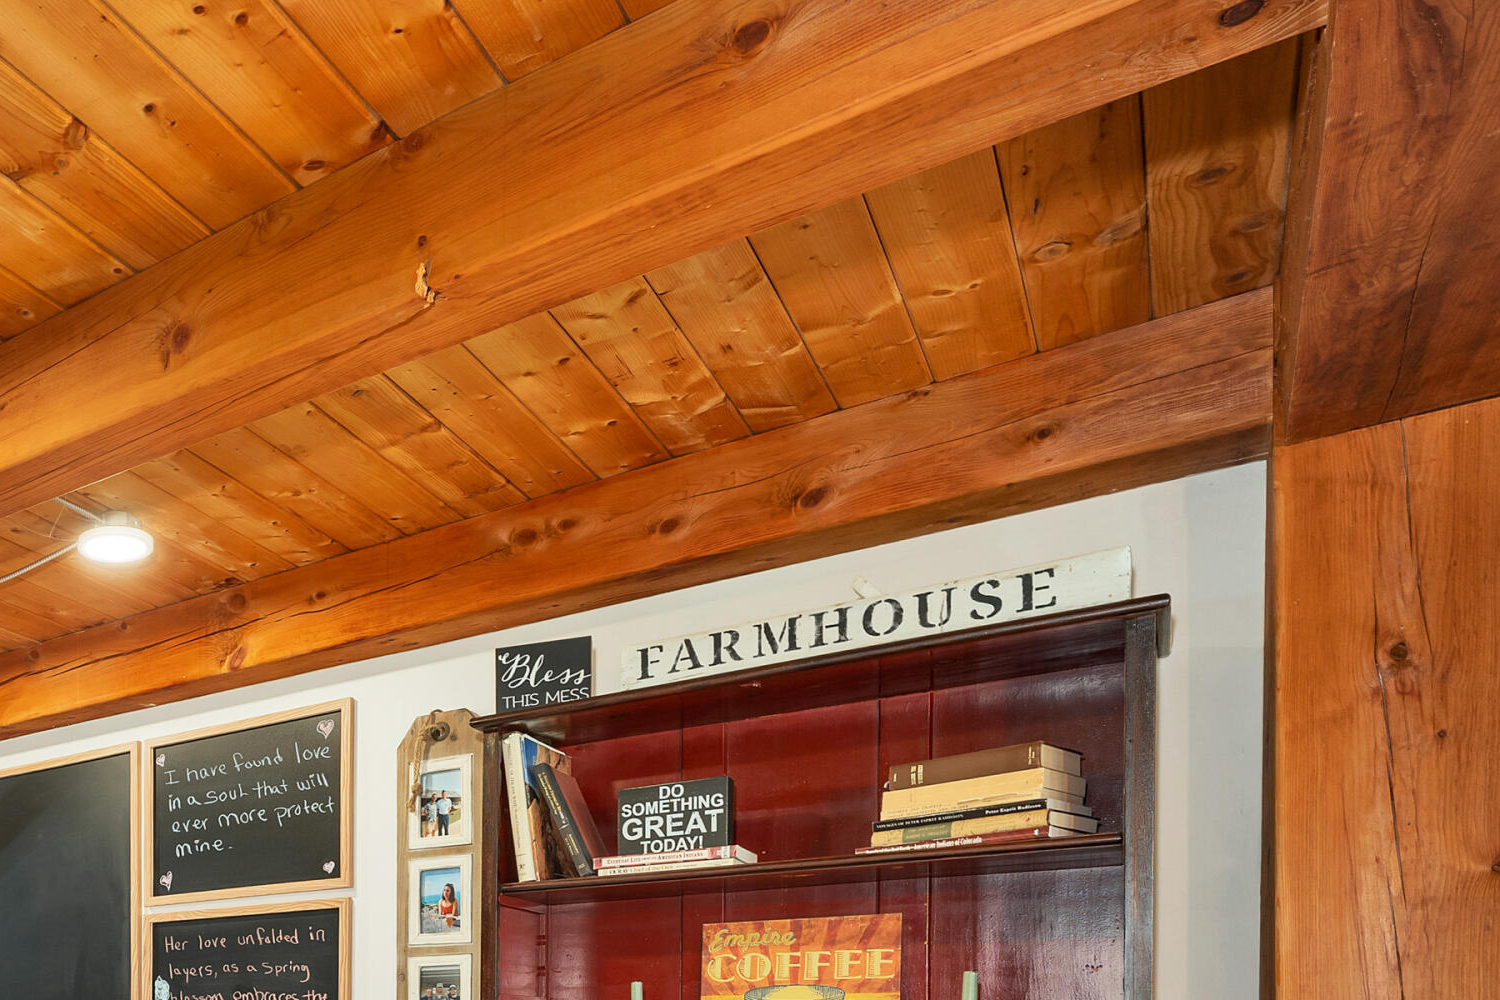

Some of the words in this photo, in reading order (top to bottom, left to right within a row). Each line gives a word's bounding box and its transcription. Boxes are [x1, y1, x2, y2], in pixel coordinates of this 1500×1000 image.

[635, 567, 1058, 681] FARMHOUSE
[498, 652, 591, 688] Bless
[501, 693, 540, 709] THIS
[545, 687, 590, 704] MESS
[164, 770, 180, 785] I
[186, 764, 227, 782] have
[232, 748, 283, 773] found
[295, 742, 332, 764] love
[168, 794, 181, 812] in
[187, 796, 202, 805] a
[252, 779, 288, 799] that
[297, 773, 329, 791] will
[621, 793, 724, 818] SOMETHING
[659, 784, 684, 799] DO
[171, 817, 208, 833] ever
[218, 808, 268, 828] more
[274, 796, 335, 828] protect
[622, 809, 724, 840] GREAT
[640, 835, 703, 854] TODAY!
[165, 936, 188, 952] Her
[199, 935, 227, 950] love
[308, 926, 325, 942] in
[709, 927, 797, 952] Empire
[169, 963, 218, 983] layers,
[222, 963, 239, 973] as
[707, 949, 895, 983] COFFEE
